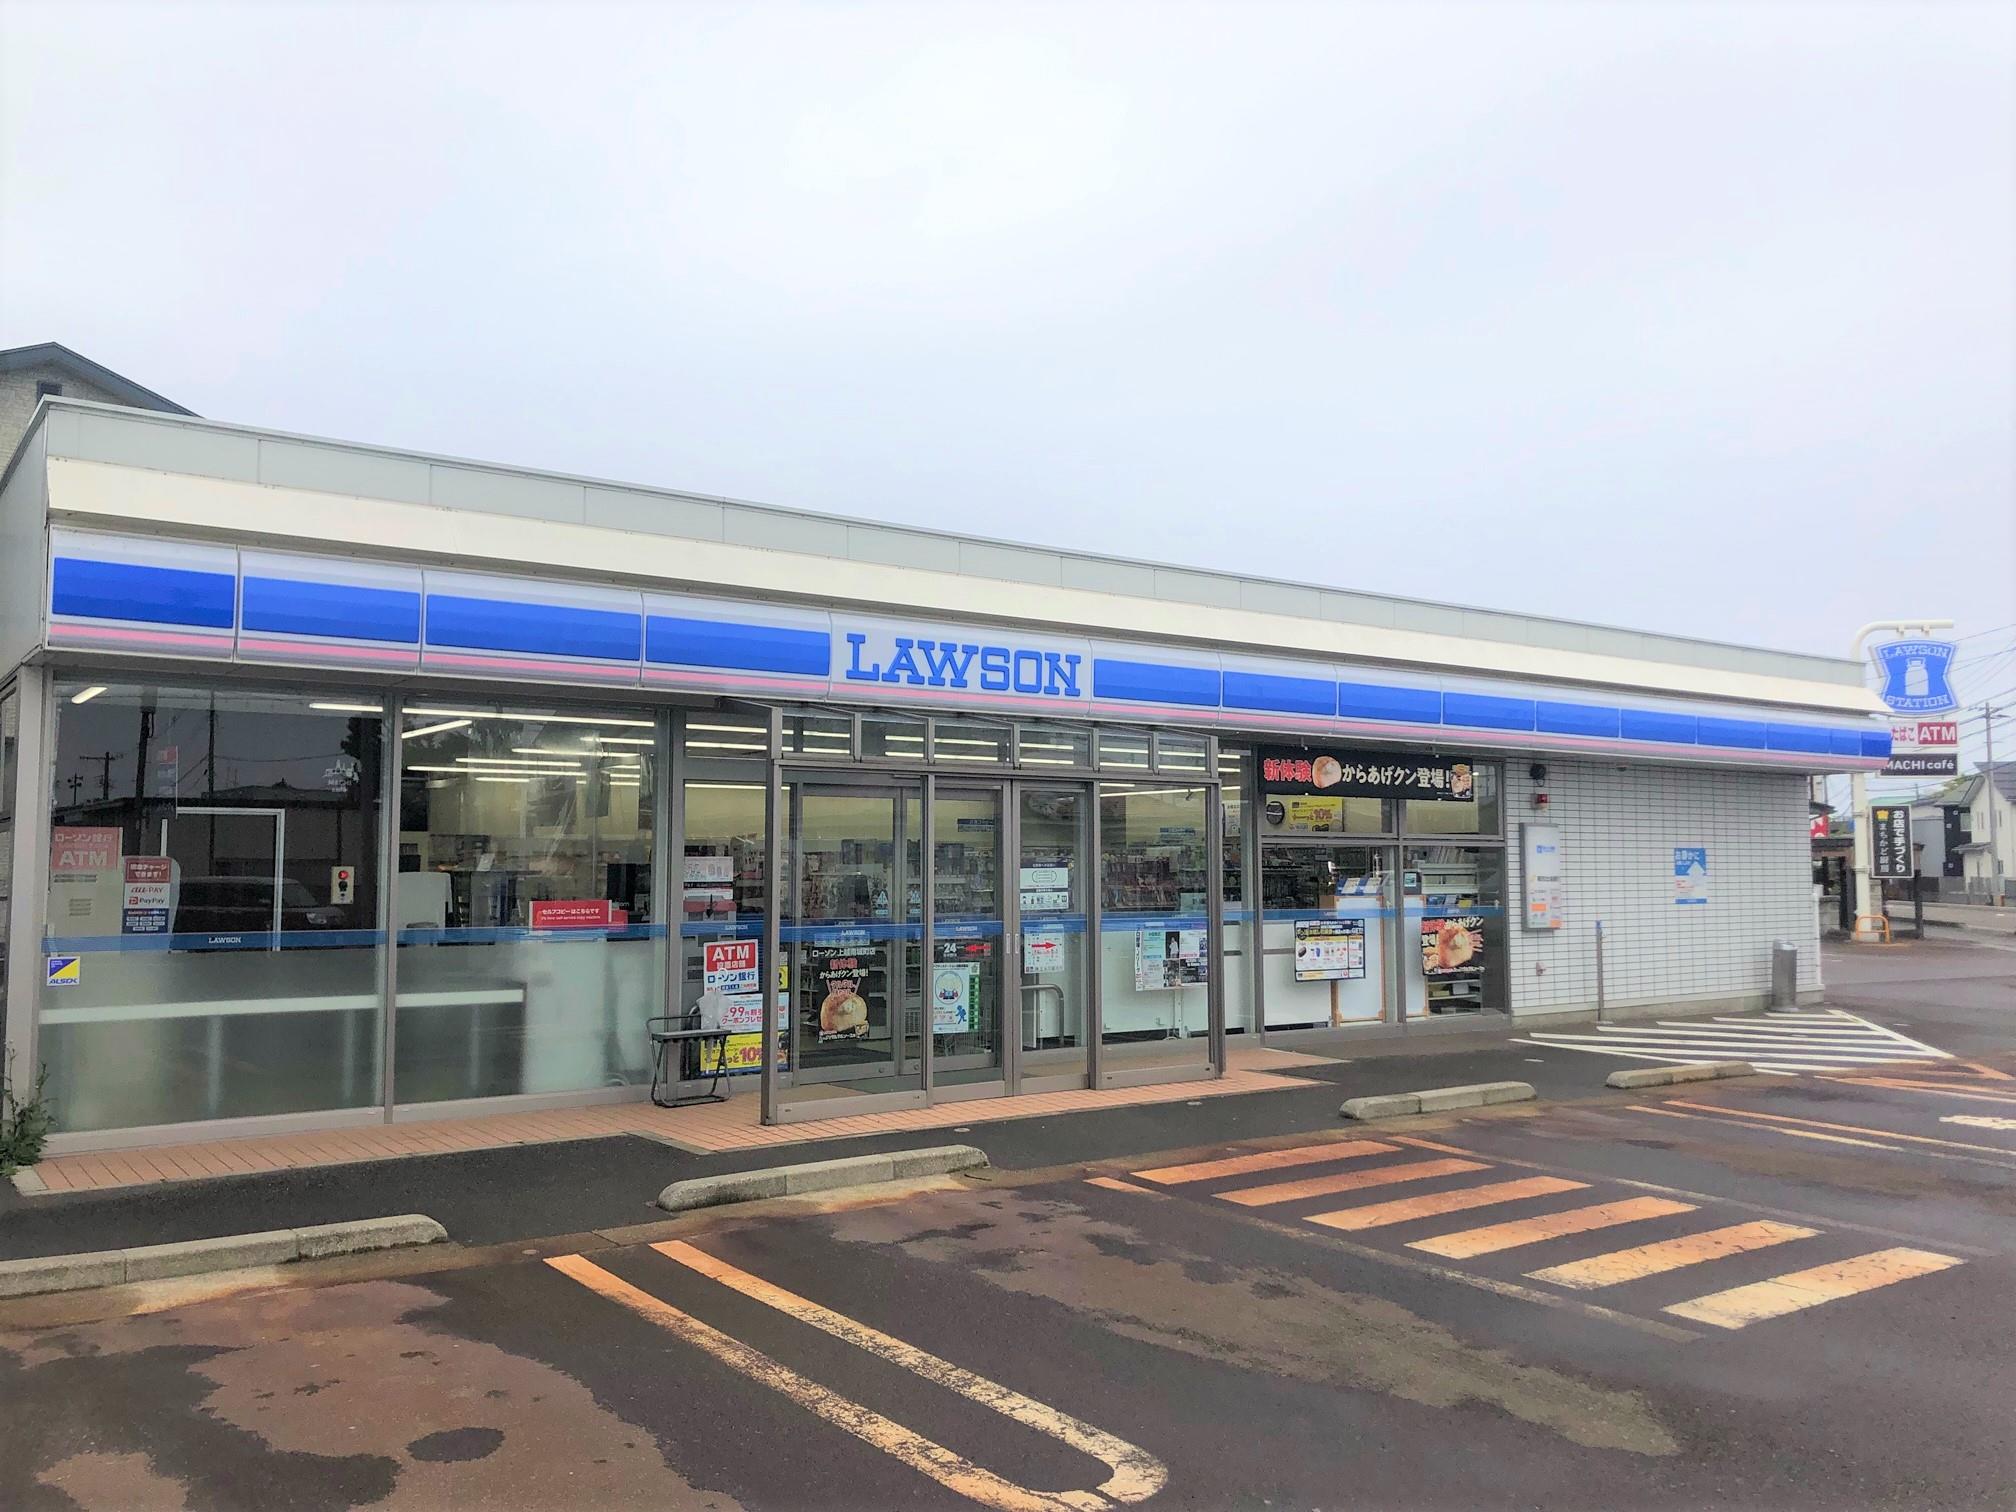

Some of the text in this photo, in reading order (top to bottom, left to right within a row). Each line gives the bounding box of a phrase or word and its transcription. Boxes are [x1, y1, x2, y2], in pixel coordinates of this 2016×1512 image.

[1882, 645, 1950, 659] LAWSON
[846, 633, 1081, 697] LAWSON
[1886, 694, 1950, 708] STATION
[1920, 726, 1955, 741] ATM
[1927, 759, 1954, 770] café
[1264, 759, 1450, 789] 新体験 からあげクン登場!
[59, 850, 108, 866] ATM
[712, 945, 750, 962] ATM
[943, 943, 957, 953] 24
[708, 971, 755, 983] ローソン銀行
